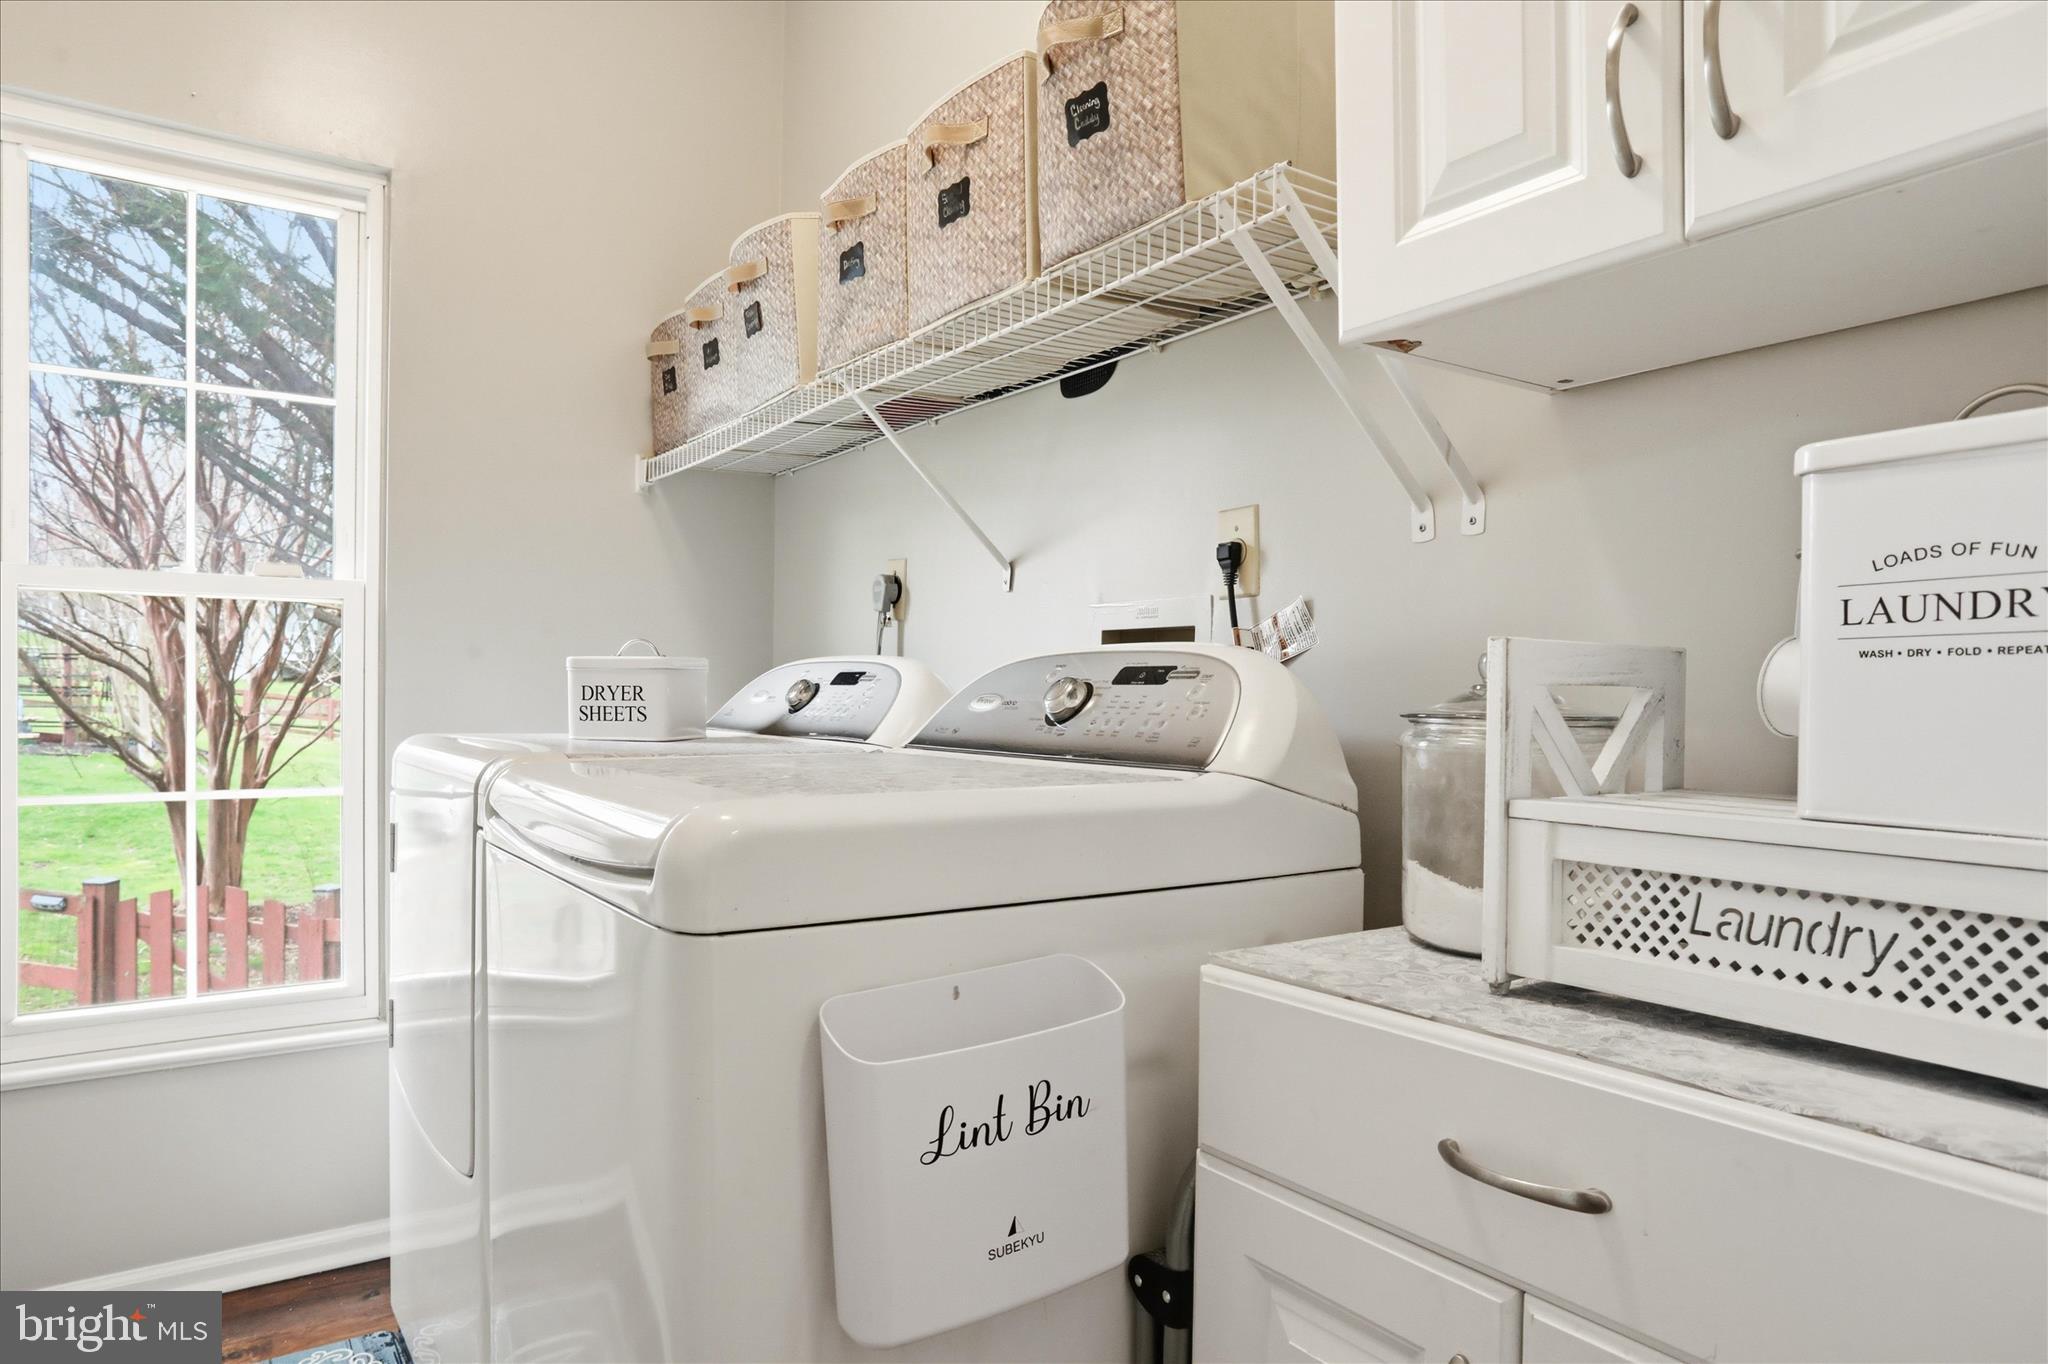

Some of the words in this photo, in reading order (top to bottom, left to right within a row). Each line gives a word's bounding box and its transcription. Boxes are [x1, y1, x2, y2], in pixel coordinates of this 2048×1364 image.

[1872, 544, 1943, 572] LOADS
[1951, 541, 1982, 556] OF
[1990, 541, 2038, 560] FUN
[1840, 586, 2048, 627] LAUNDR
[1858, 649, 1894, 659] WASH
[1906, 648, 1932, 658] DRY
[1947, 646, 1982, 657] FOLD
[581, 684, 646, 702] DRYER
[579, 705, 648, 722] SHEETS
[1690, 892, 1900, 978] Laundry
[920, 1094, 1014, 1166] Lint
[1025, 1079, 1091, 1136] Bin
[988, 1231, 1046, 1261] SUBEKYU
